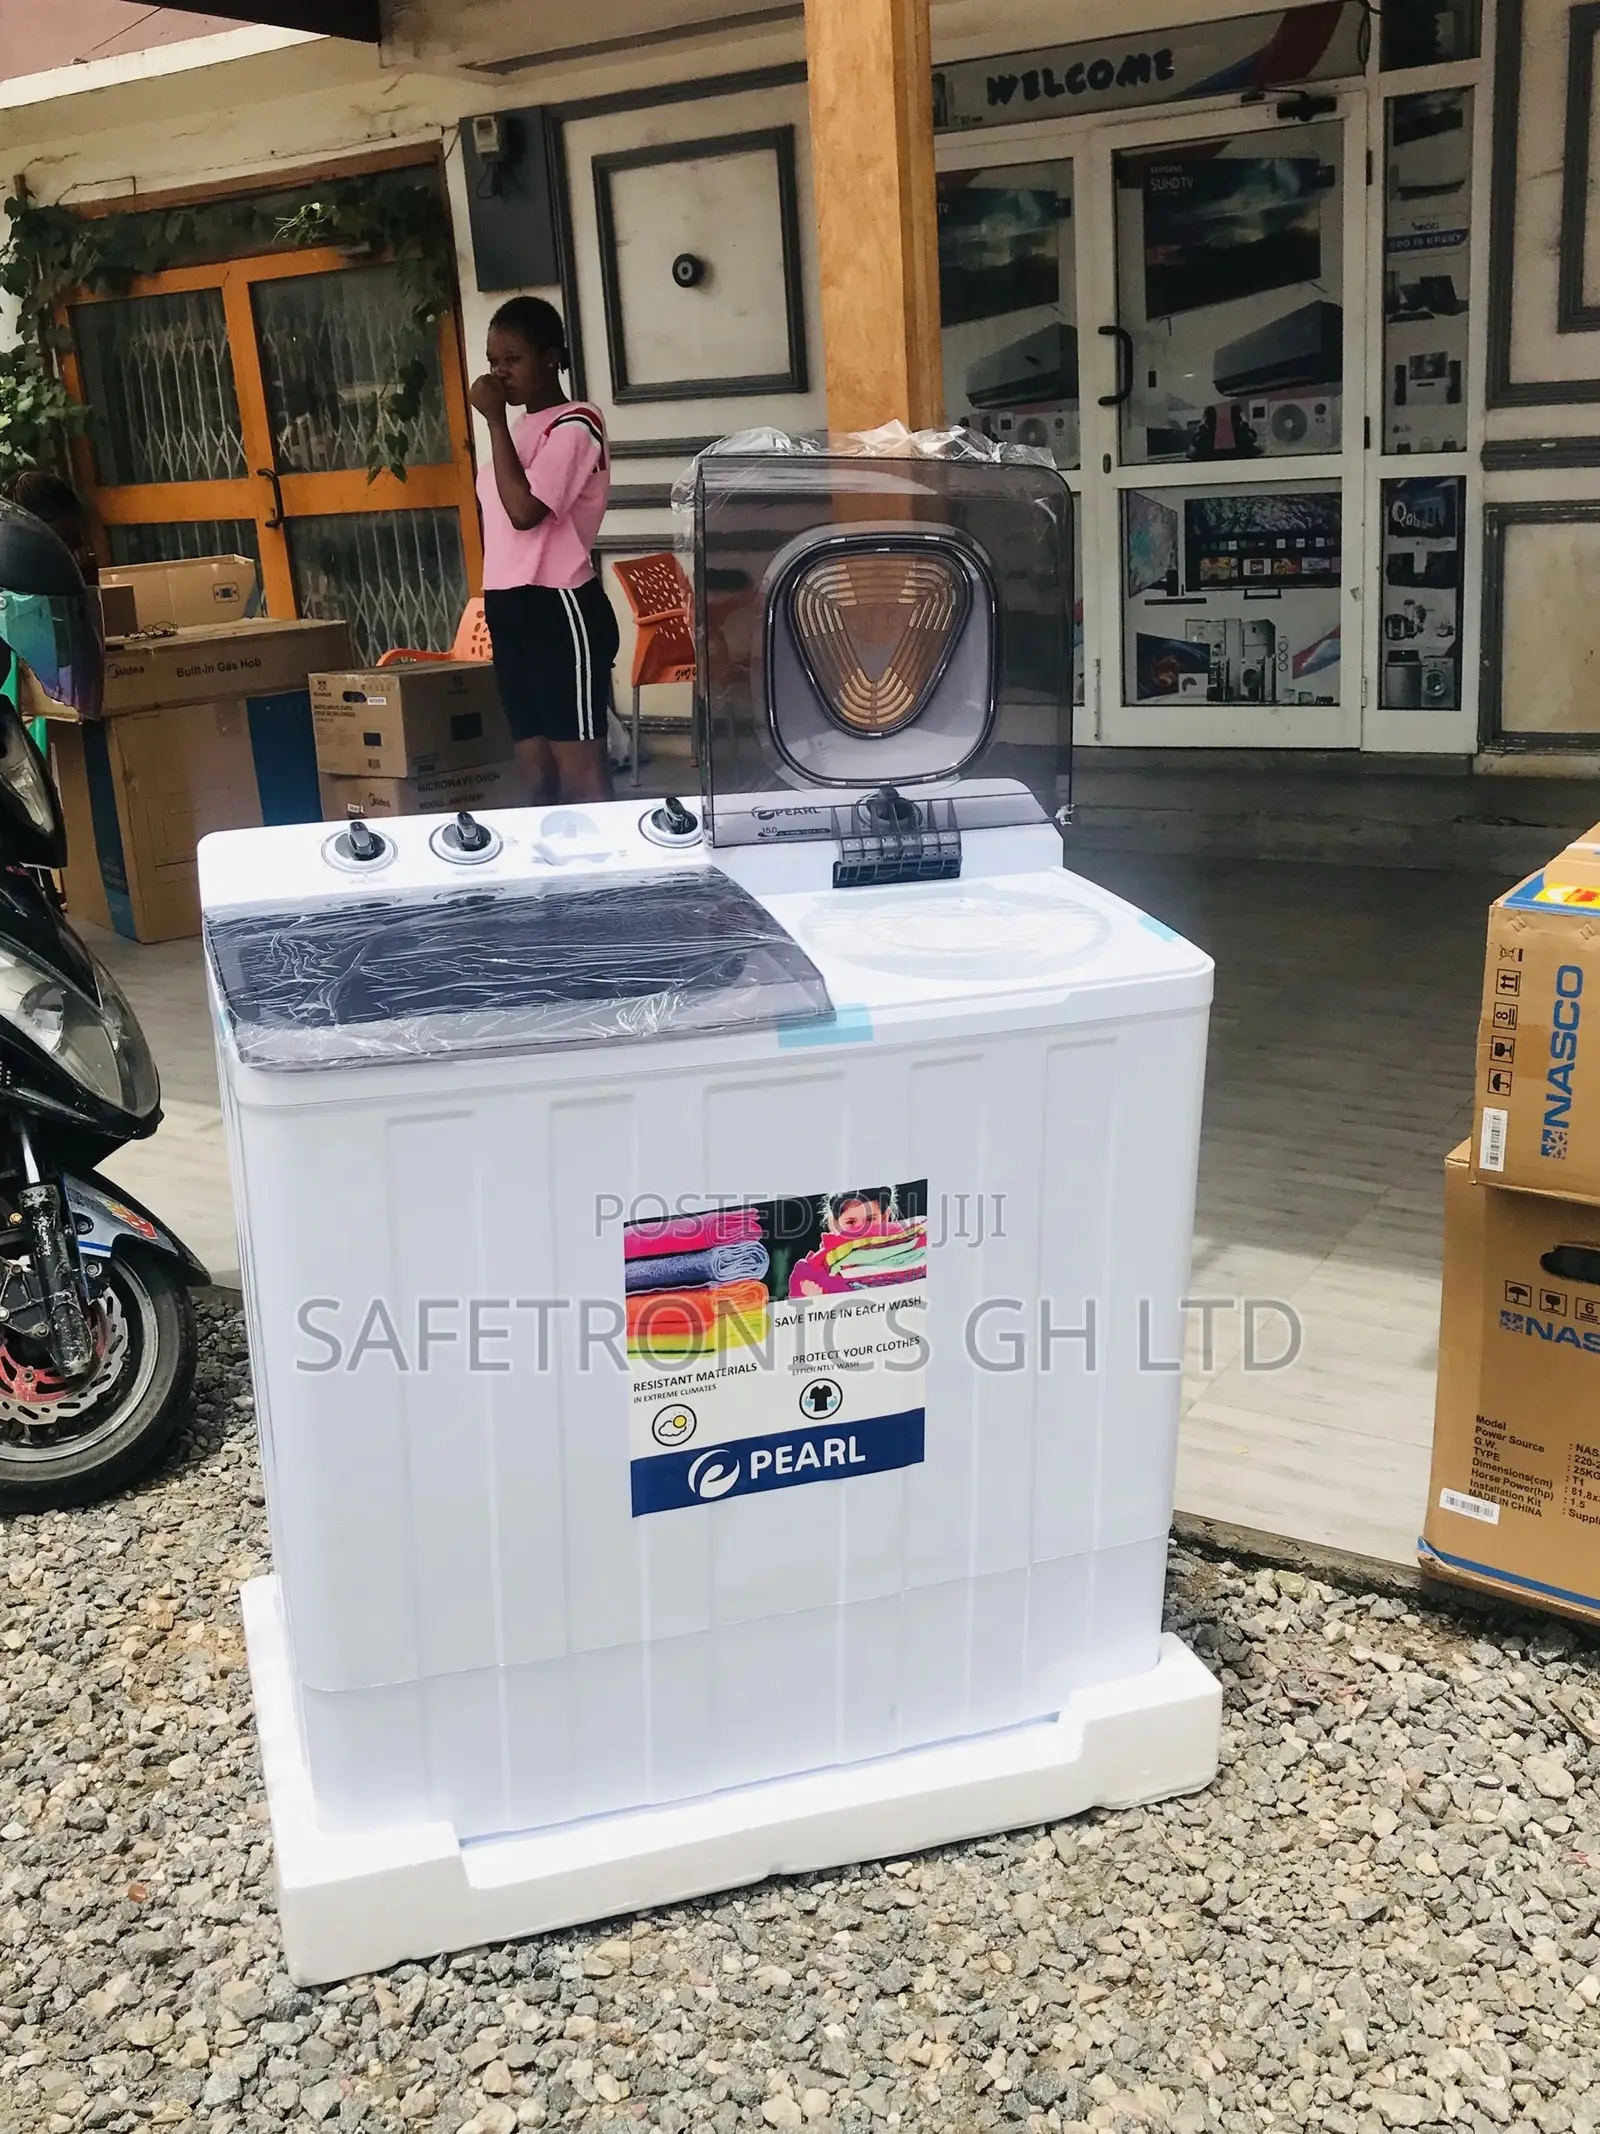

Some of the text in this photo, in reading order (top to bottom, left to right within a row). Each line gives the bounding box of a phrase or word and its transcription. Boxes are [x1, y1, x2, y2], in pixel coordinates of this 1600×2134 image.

[987, 48, 1175, 106] WELCOME
[217, 661, 238, 673] Gas
[240, 657, 262, 670] Hob
[775, 806, 821, 817] PEARL
[1544, 964, 1584, 1129] NASCO
[775, 1296, 921, 1327] SAVE TIME IN EACH WASH
[792, 1336, 920, 1364] PROTECT YOUR CLOTHES
[633, 1362, 757, 1392] RESISTANT MATERIALS
[792, 1361, 859, 1376] EFFICIENTLY WASH
[633, 1384, 717, 1404] IN EXTREME CLIMATES
[1475, 1415, 1506, 1430] Model
[1474, 1436, 1497, 1450] G.W.
[1475, 1426, 1506, 1442] Power
[1509, 1436, 1545, 1452] Source
[750, 1435, 866, 1480] PEARL
[1473, 1447, 1584, 1486] TYPE T1
[1472, 1458, 1553, 1489] Dimensions(cm)
[1470, 1479, 1524, 1502] Installation
[1527, 1496, 1542, 1508] Kit
[1471, 1468, 1585, 1509] Horse Power(hp) 1.5
[1469, 1489, 1498, 1504] MADE
[1511, 1501, 1542, 1518] CHINA
